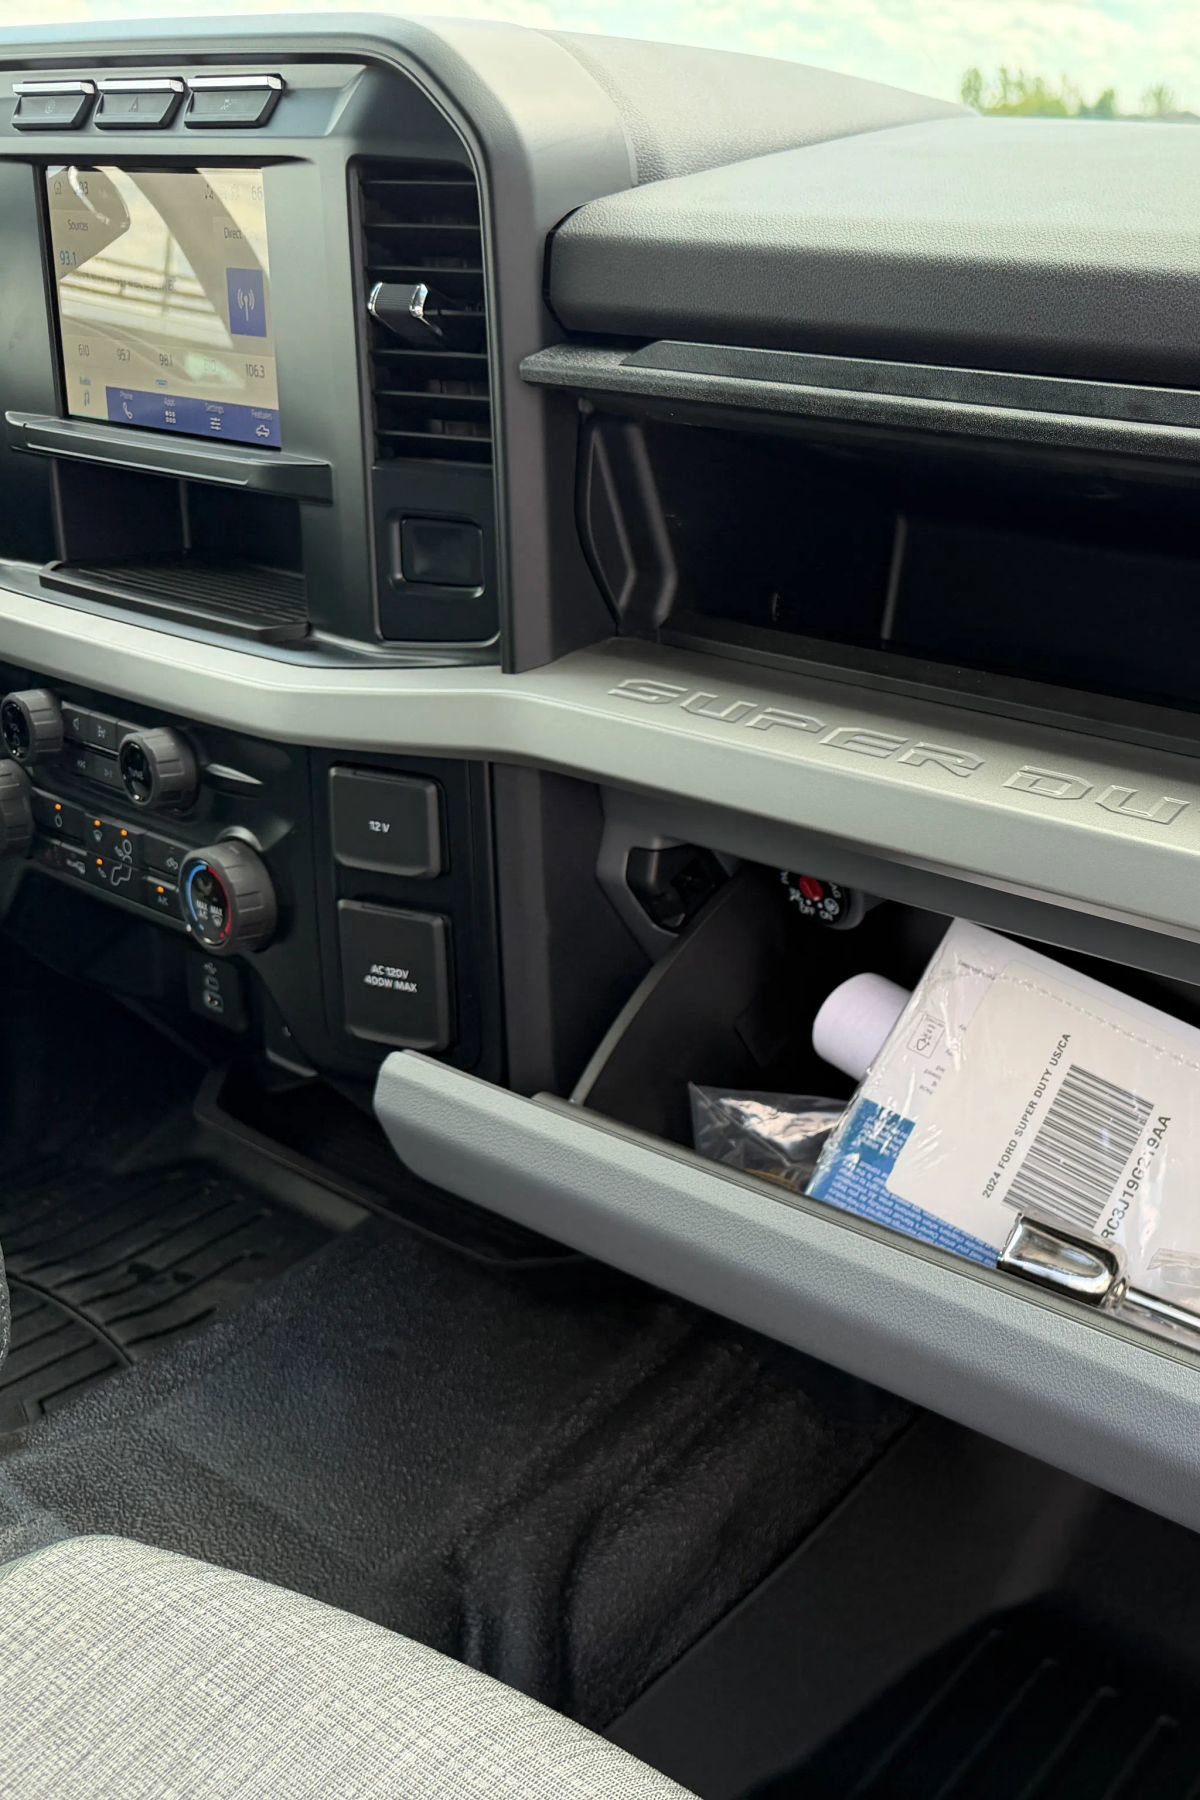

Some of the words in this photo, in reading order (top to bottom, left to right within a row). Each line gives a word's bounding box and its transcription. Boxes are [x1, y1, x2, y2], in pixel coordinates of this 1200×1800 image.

[60, 250, 77, 266] 93.1
[245, 364, 265, 379] 106.3
[607, 677, 985, 779] SUPER
[369, 820, 381, 832] 12
[382, 823, 391, 833] V
[370, 964, 384, 975] AC
[385, 966, 410, 980] 120V
[364, 975, 393, 988] 400W
[394, 980, 418, 993] MAX
[982, 1171, 1001, 1199] 2024
[998, 1138, 1018, 1169] FORD
[1014, 1099, 1039, 1137] SUPER
[1033, 1068, 1053, 1099] DUTY
[1049, 1033, 1072, 1067] US/CA
